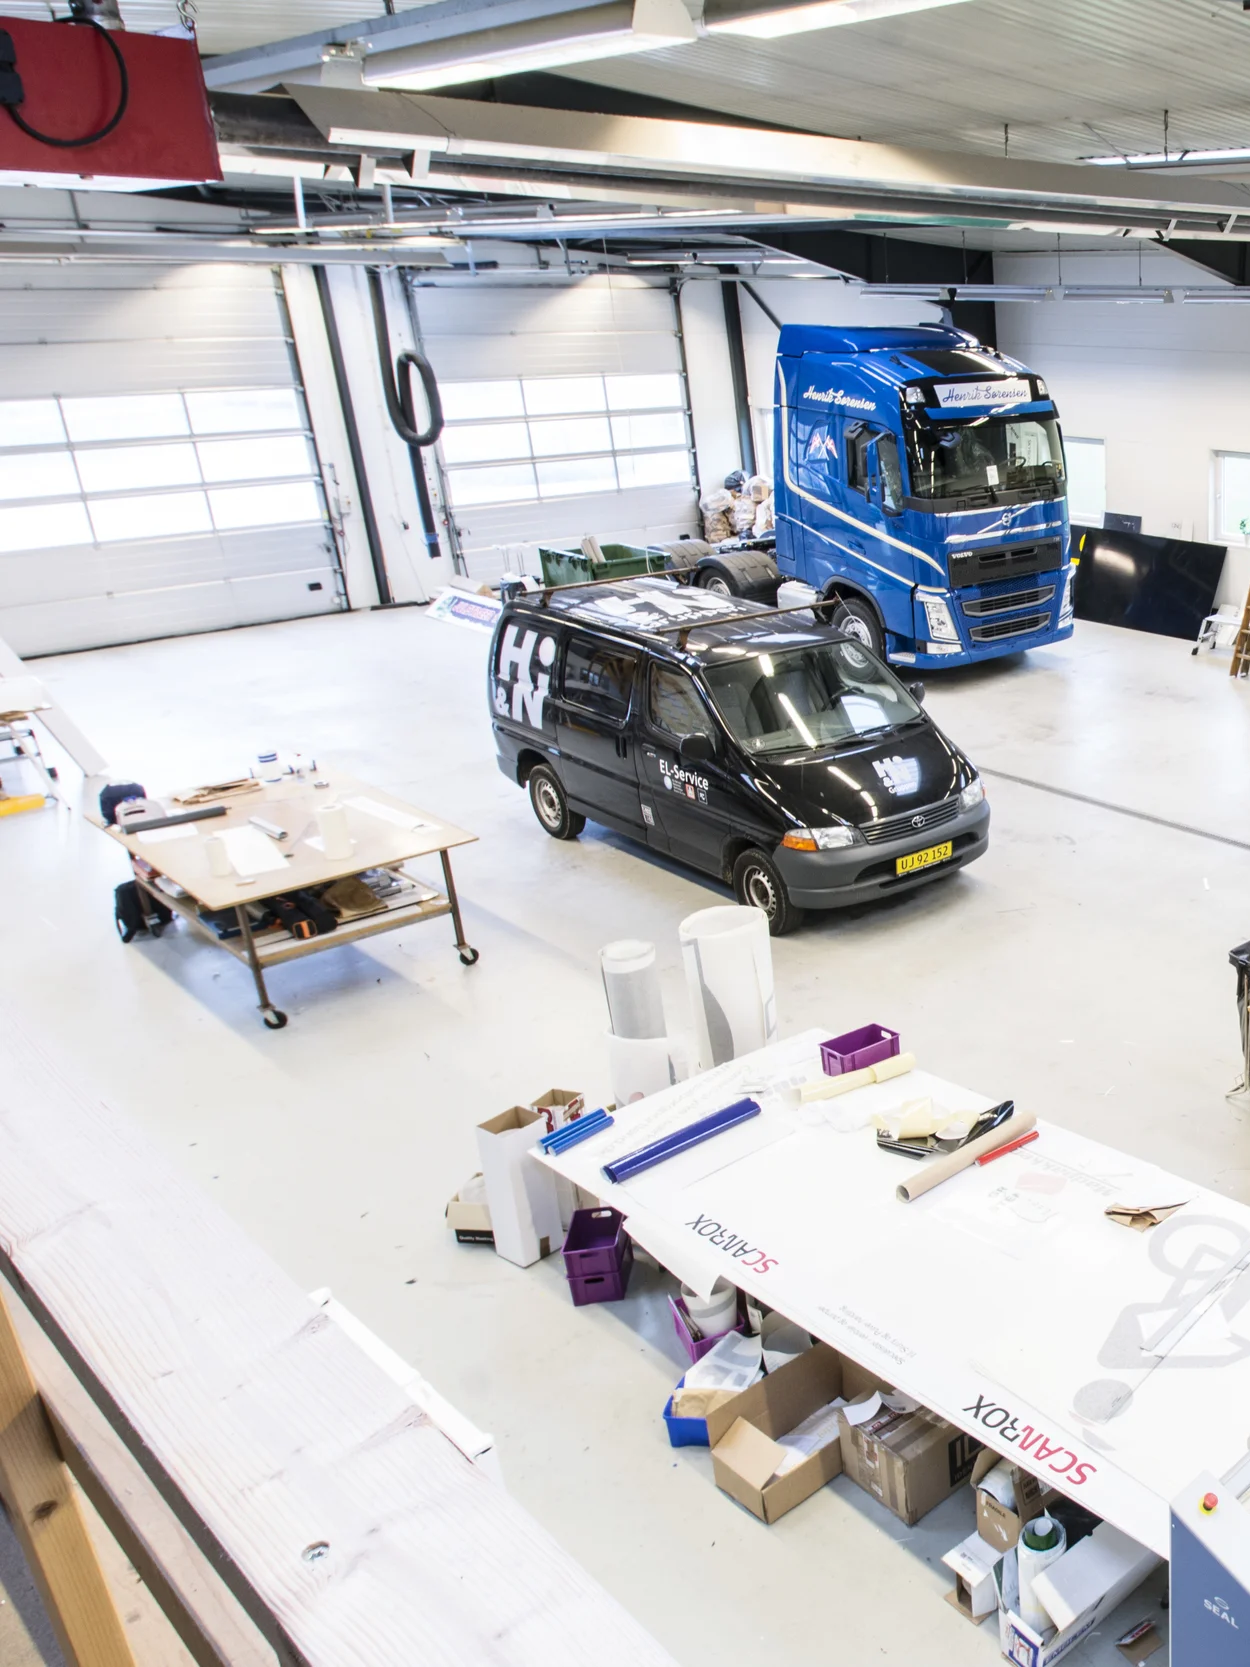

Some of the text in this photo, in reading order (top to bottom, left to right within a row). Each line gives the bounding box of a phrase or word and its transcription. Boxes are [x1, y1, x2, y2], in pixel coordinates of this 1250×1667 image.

[803, 385, 835, 403] Henrik
[942, 385, 984, 403] Henrik
[951, 551, 973, 560] VOLVO
[660, 759, 709, 790] EL-Service
[901, 845, 949, 870] UJ 92 152
[684, 1213, 780, 1274] SCANROX
[961, 1394, 1097, 1486] SCANROX
[1203, 1598, 1239, 1630] SEAL
